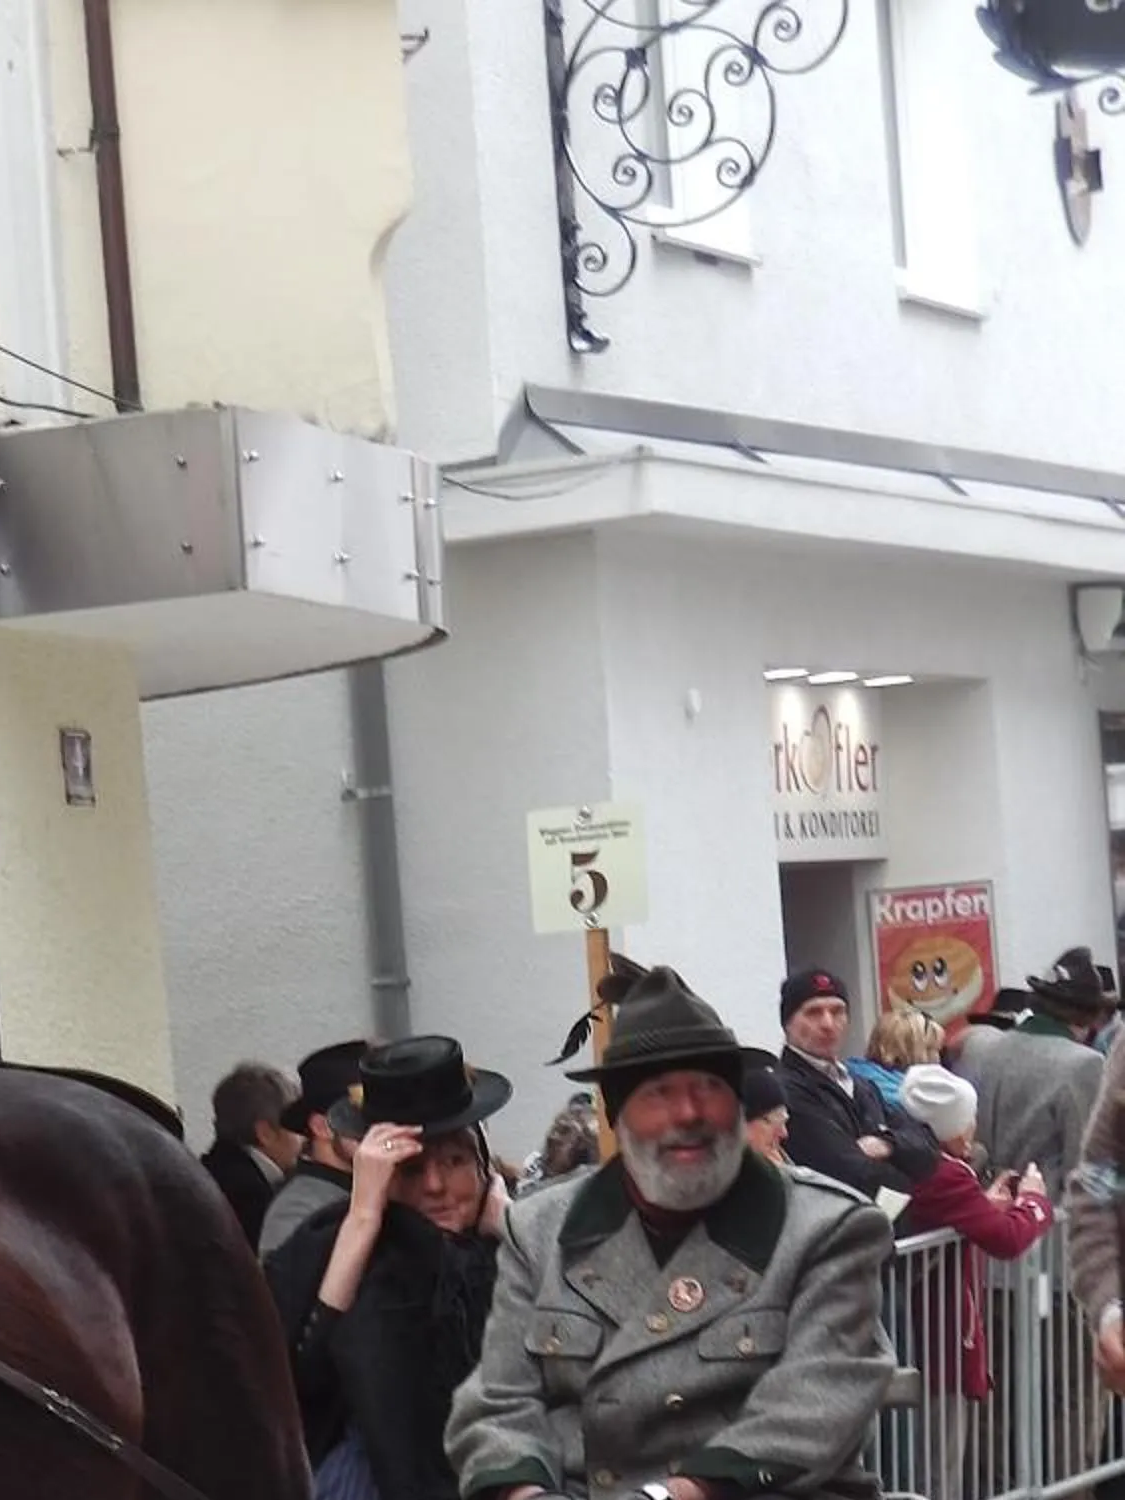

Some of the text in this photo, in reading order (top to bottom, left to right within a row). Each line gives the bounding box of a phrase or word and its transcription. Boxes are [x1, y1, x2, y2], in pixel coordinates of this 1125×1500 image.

[784, 811, 795, 840] &
[799, 810, 881, 841] KONDITOREI
[570, 850, 608, 914] 5
[875, 888, 991, 925] Krapfen
